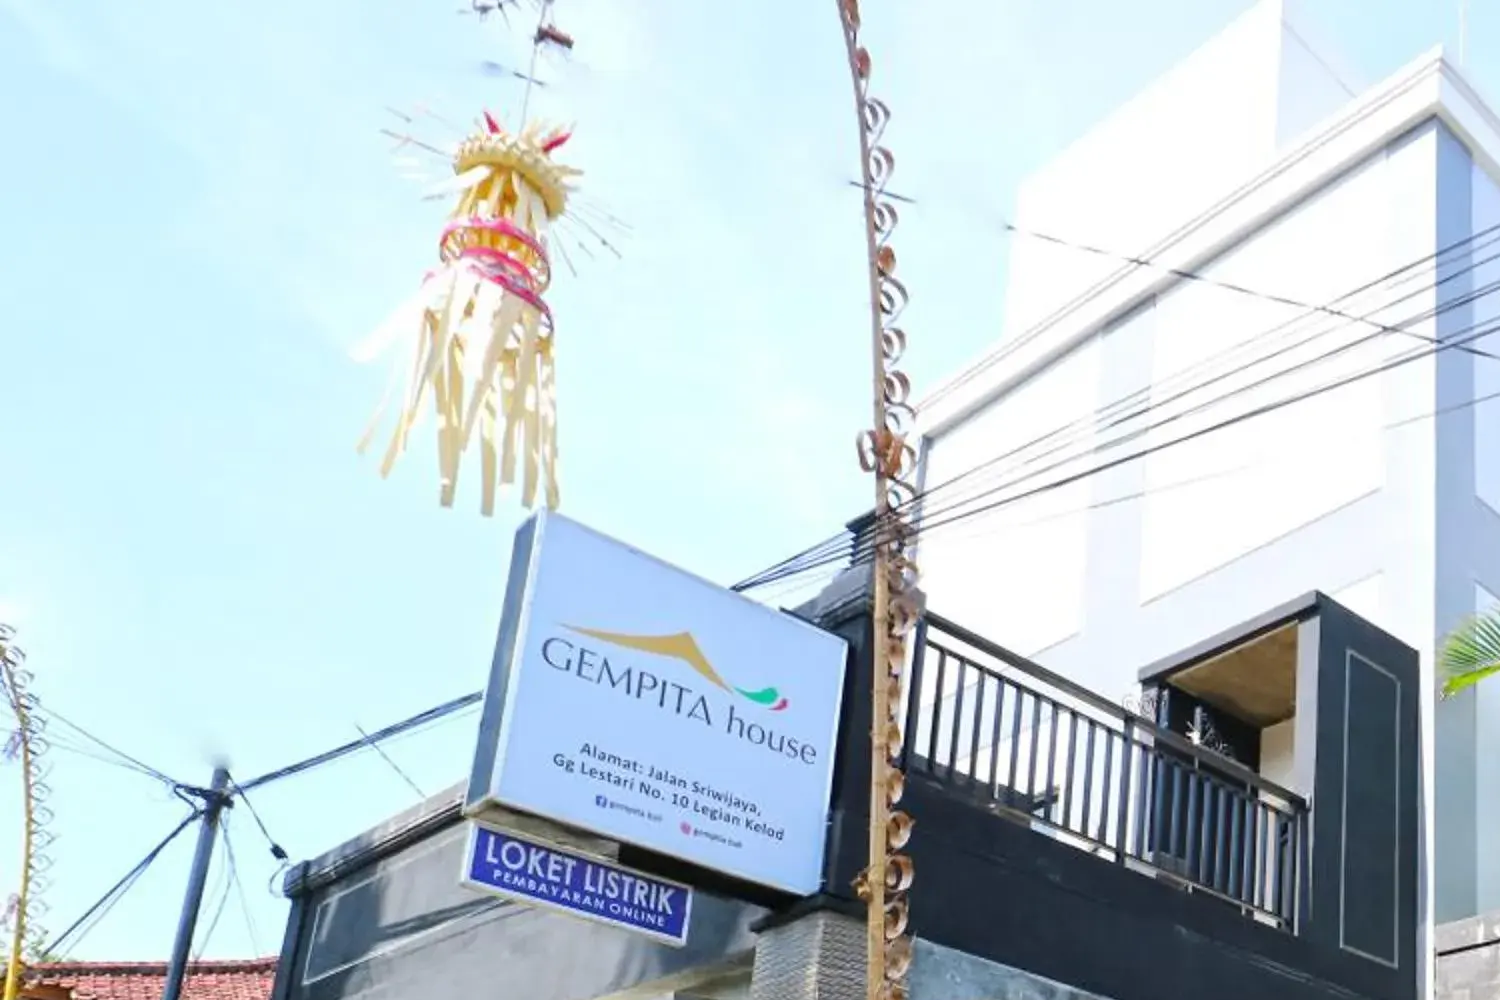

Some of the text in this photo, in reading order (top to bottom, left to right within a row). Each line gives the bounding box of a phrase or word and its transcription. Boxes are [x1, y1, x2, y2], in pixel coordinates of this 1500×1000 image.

[541, 637, 818, 765] GEMPITA house
[553, 753, 785, 841] Gg Lestari No. 10 Legian Kelod
[580, 743, 761, 817] Alamat: Jalan Sriwijaya,
[485, 835, 676, 915] LOKET LISTRIK
[493, 869, 665, 927] PEMBAYARAN ONLINE
